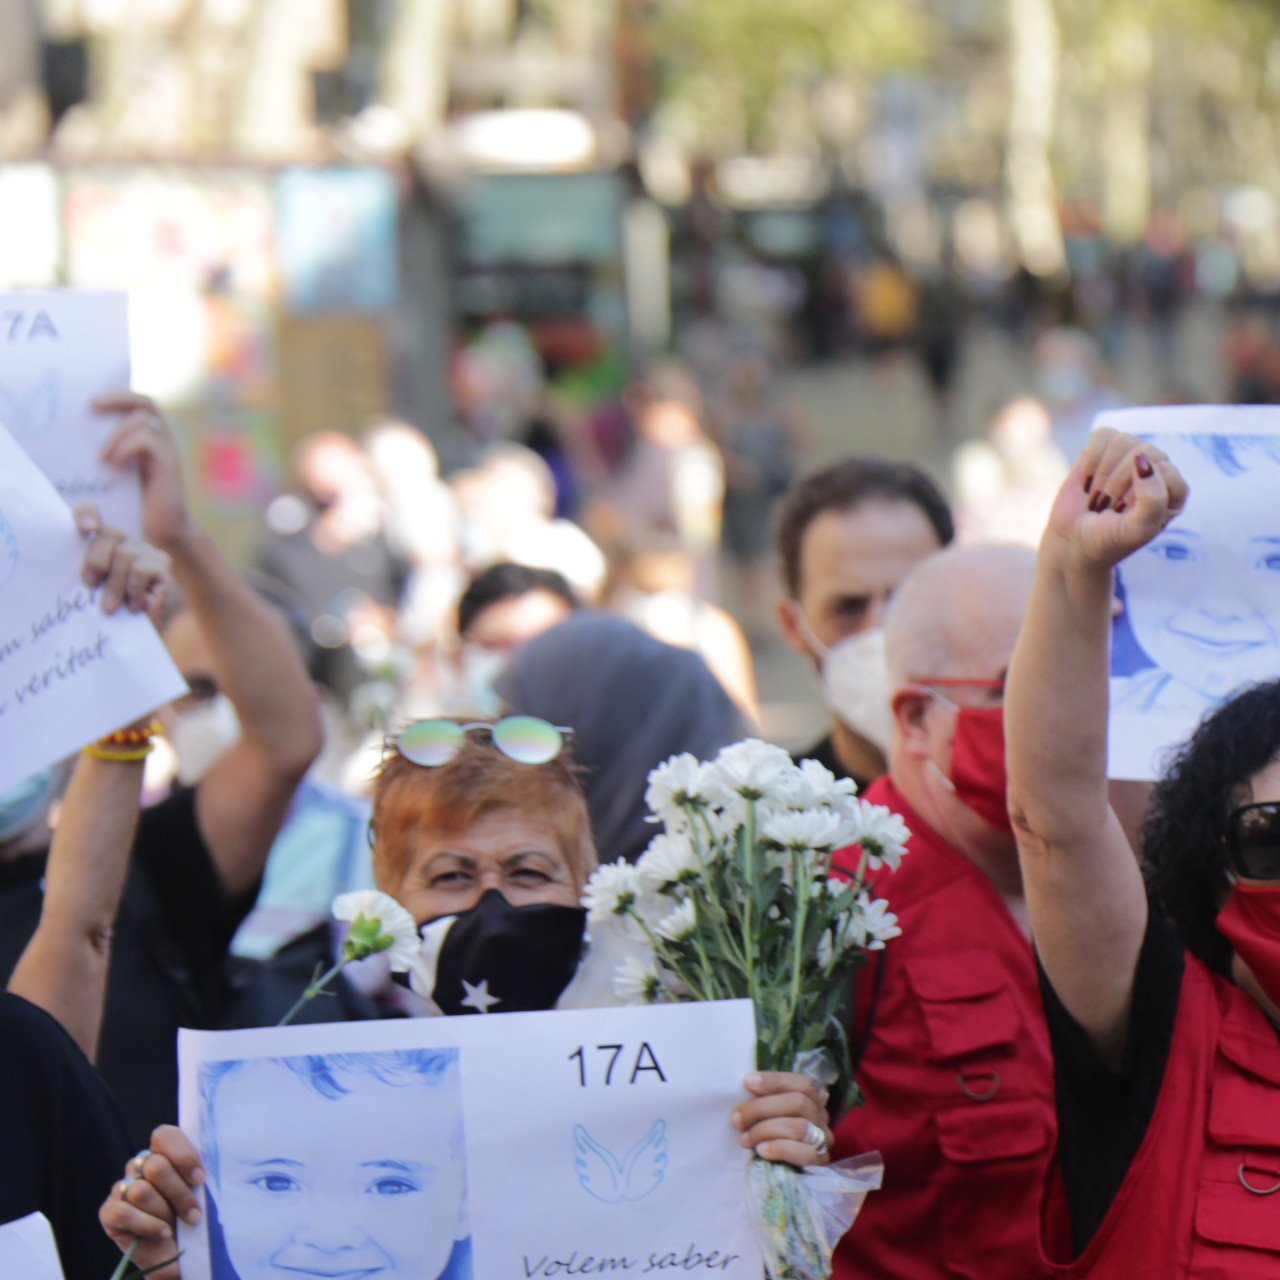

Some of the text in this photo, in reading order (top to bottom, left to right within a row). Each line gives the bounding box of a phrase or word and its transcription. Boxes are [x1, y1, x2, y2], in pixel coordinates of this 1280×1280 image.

[0, 310, 61, 341] 7A
[568, 1041, 667, 1087] 17A
[522, 1243, 741, 1278] Volem saber
